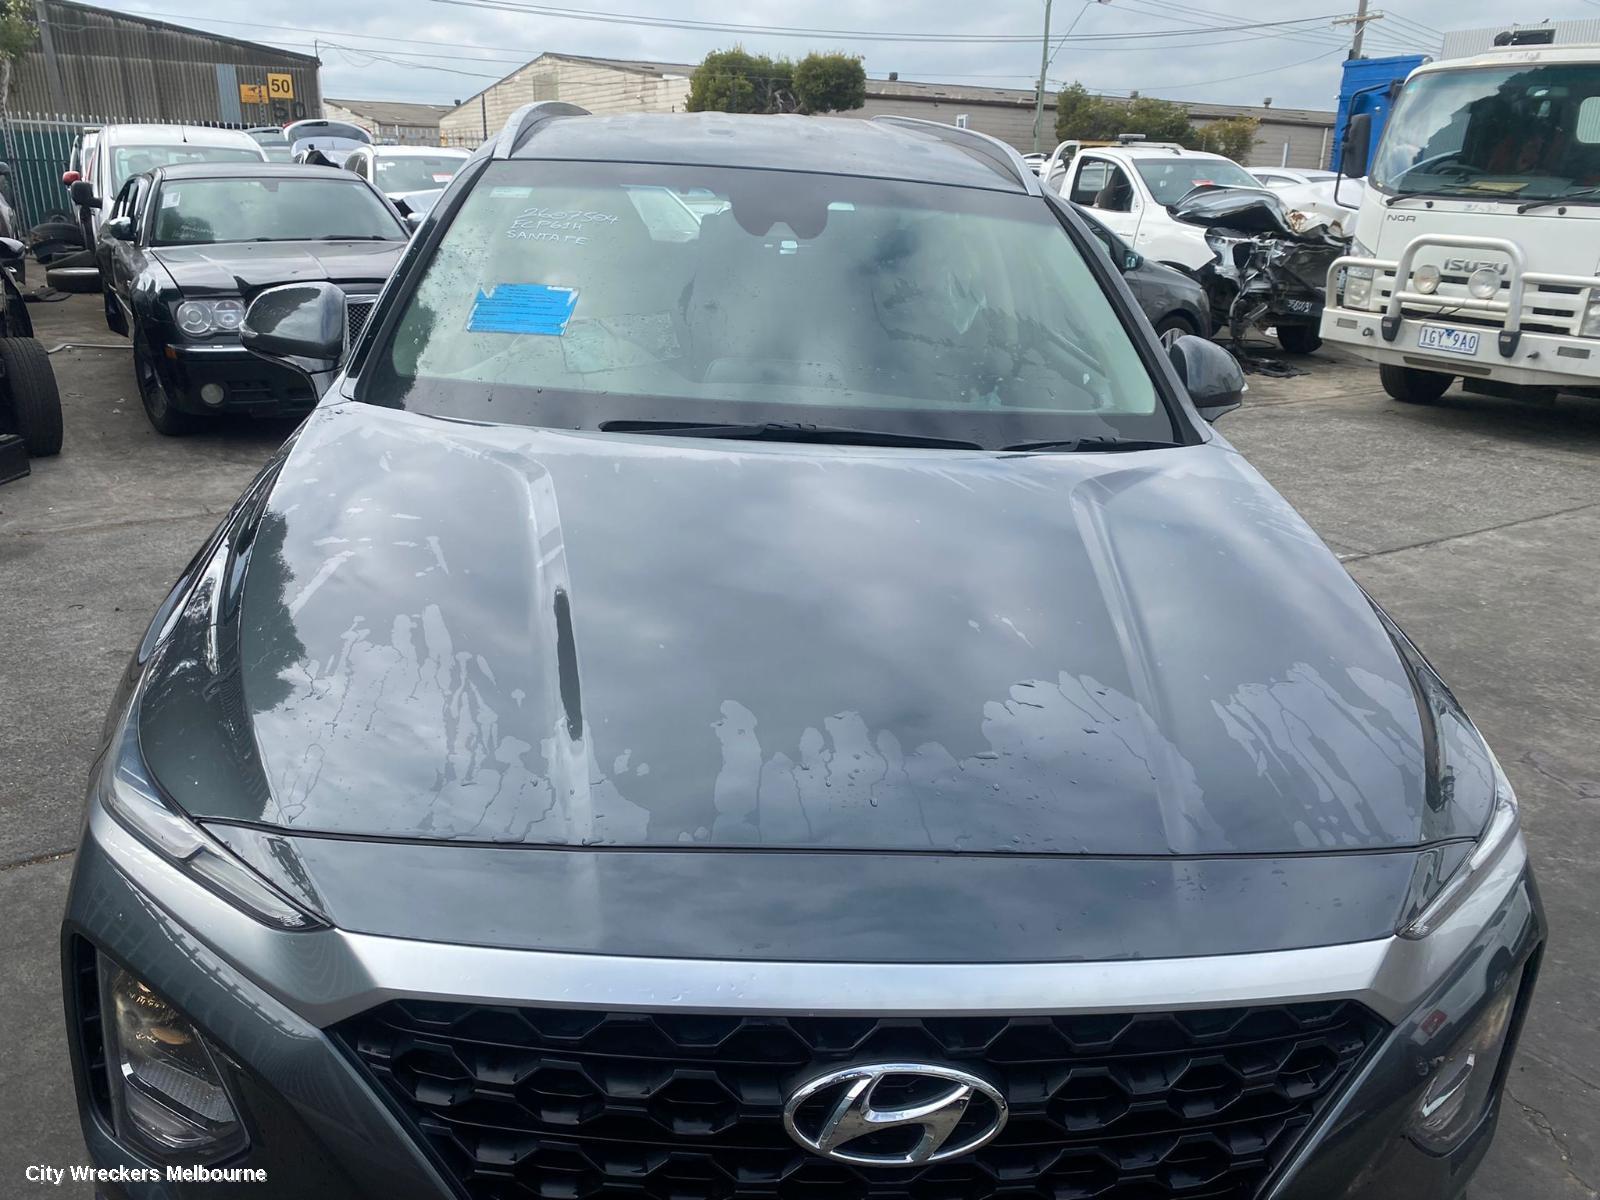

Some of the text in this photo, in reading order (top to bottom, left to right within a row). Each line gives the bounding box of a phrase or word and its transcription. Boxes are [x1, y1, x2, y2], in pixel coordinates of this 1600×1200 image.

[271, 78, 290, 93] 50
[1386, 214, 1417, 223] NQR
[506, 229, 560, 241] SANTA
[1443, 257, 1509, 276] ISUZU
